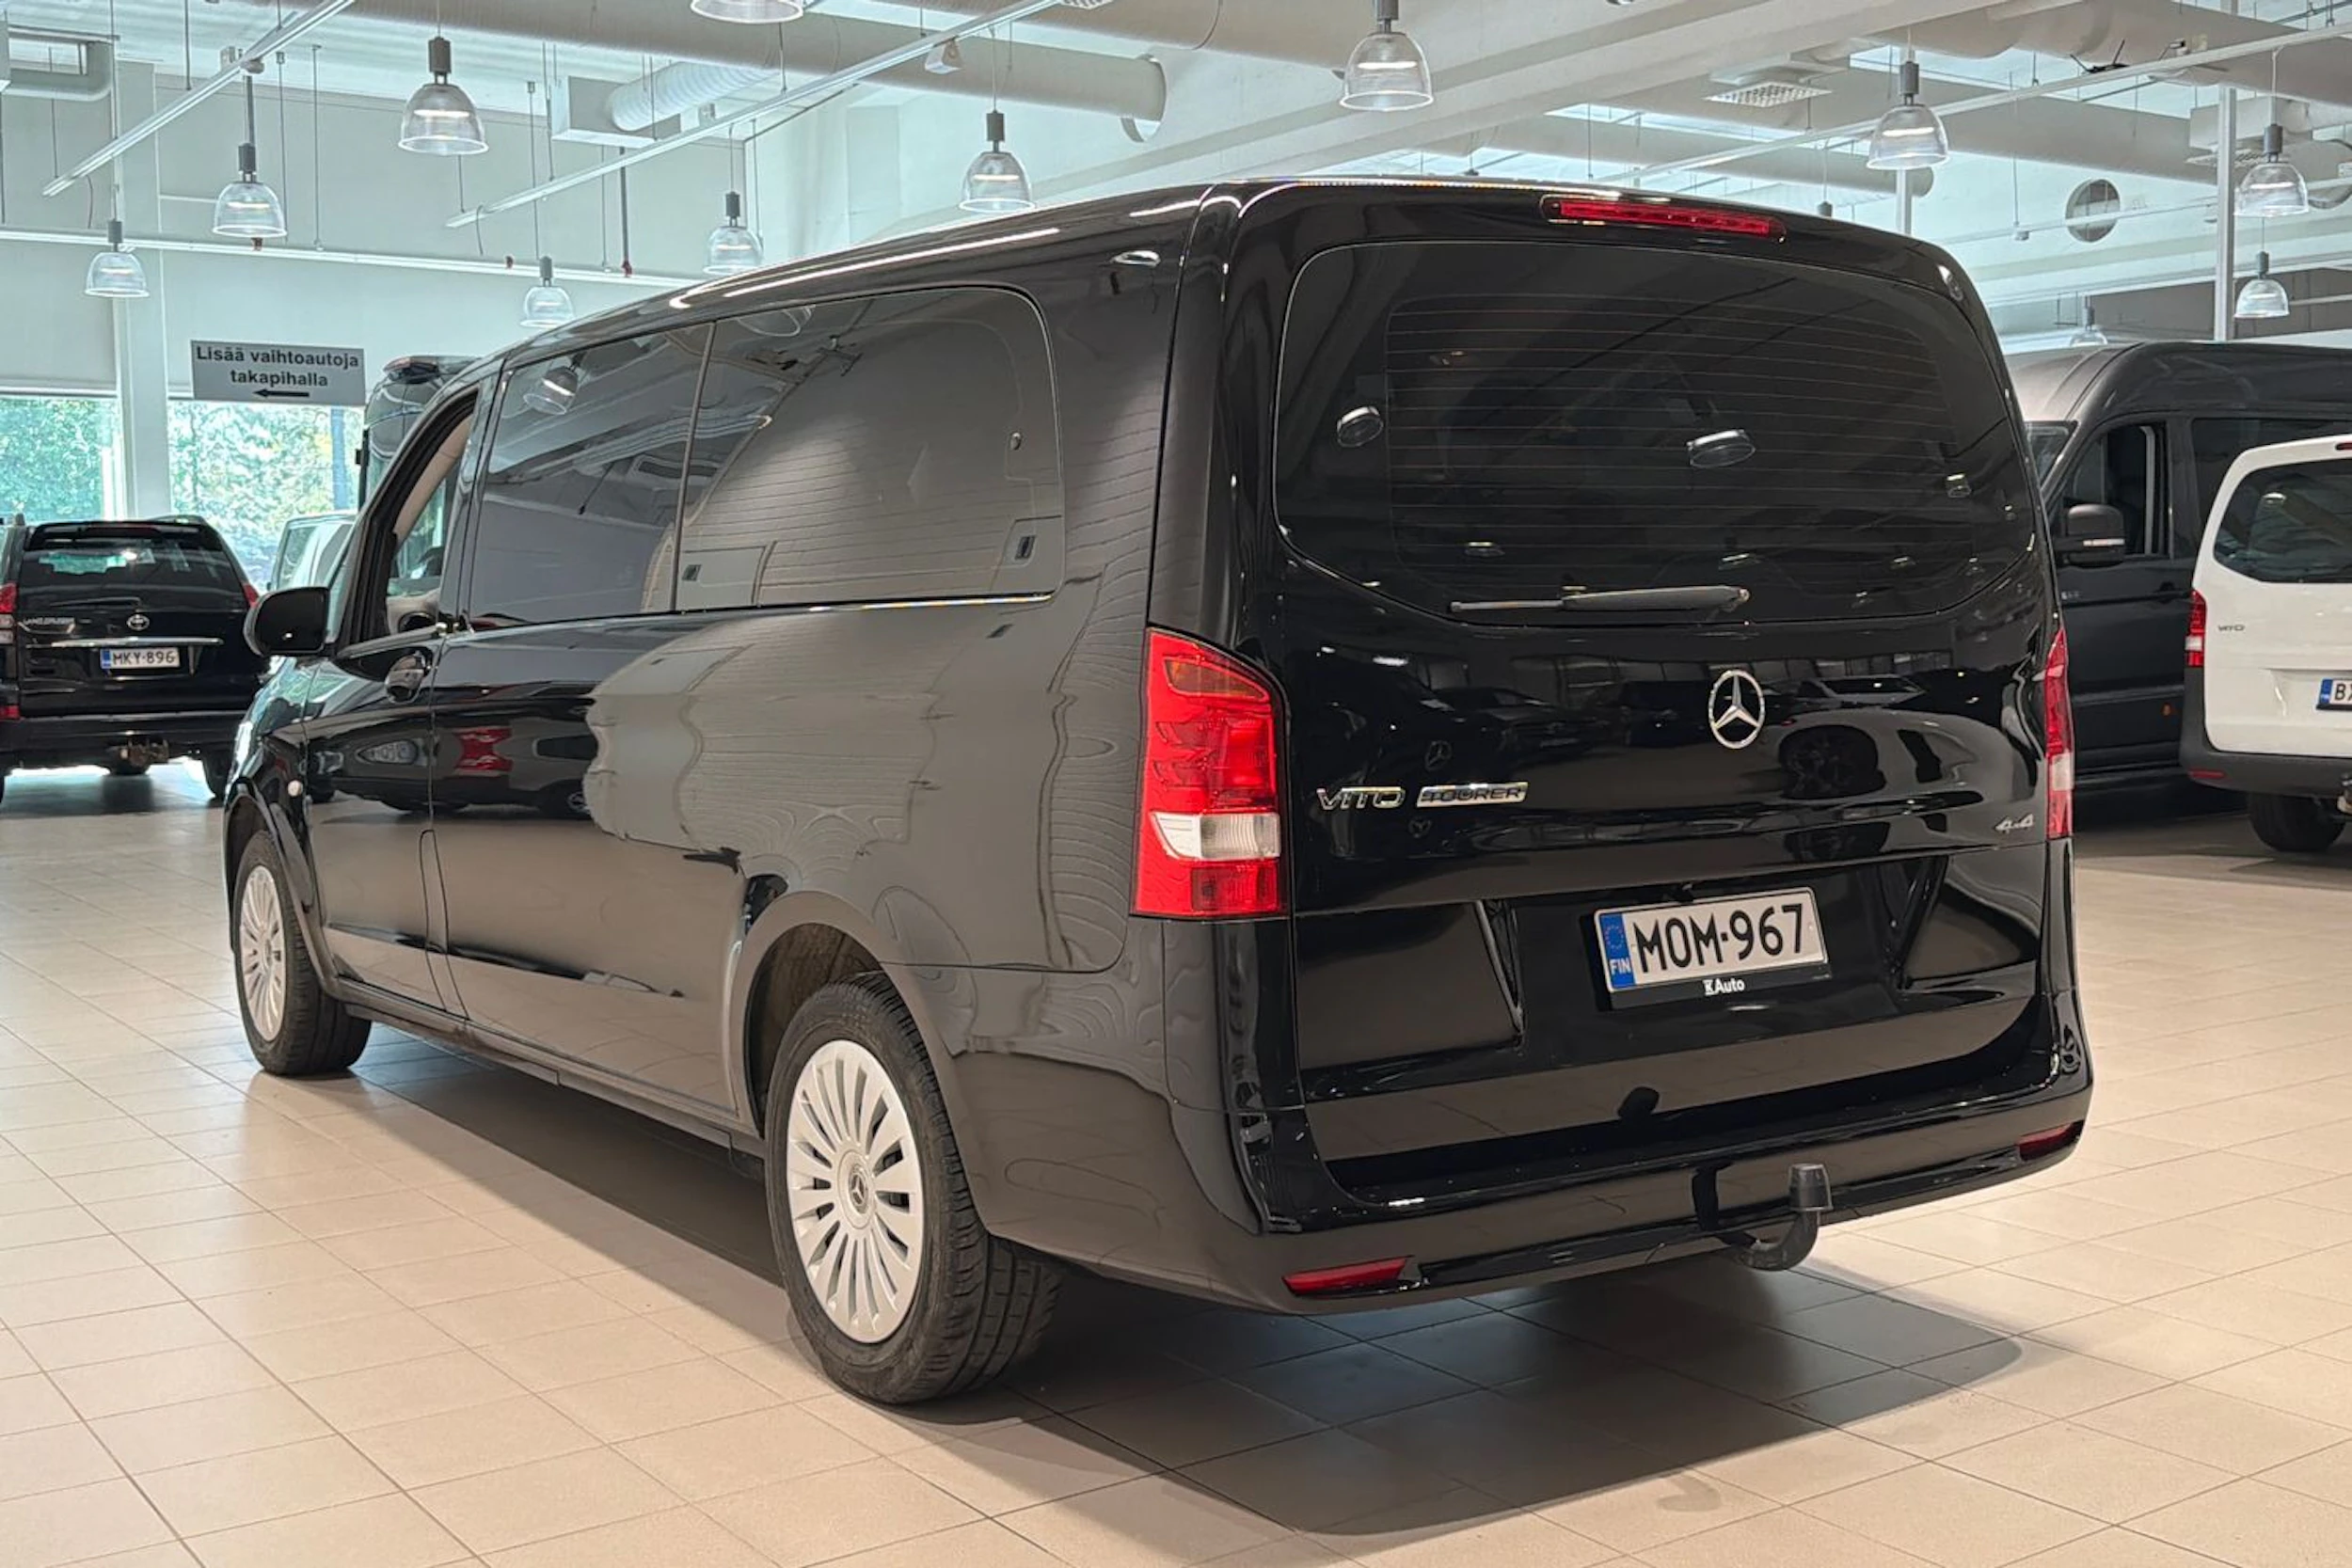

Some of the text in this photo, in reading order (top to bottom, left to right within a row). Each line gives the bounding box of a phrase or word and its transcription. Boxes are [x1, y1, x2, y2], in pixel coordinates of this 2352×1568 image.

[197, 345, 358, 371] Lisää vaihtoautoja
[230, 369, 328, 388] takapihalla
[113, 650, 176, 666] MKY-896
[1316, 785, 1406, 810] VITO
[1609, 902, 1804, 975] FIN MOM-967
